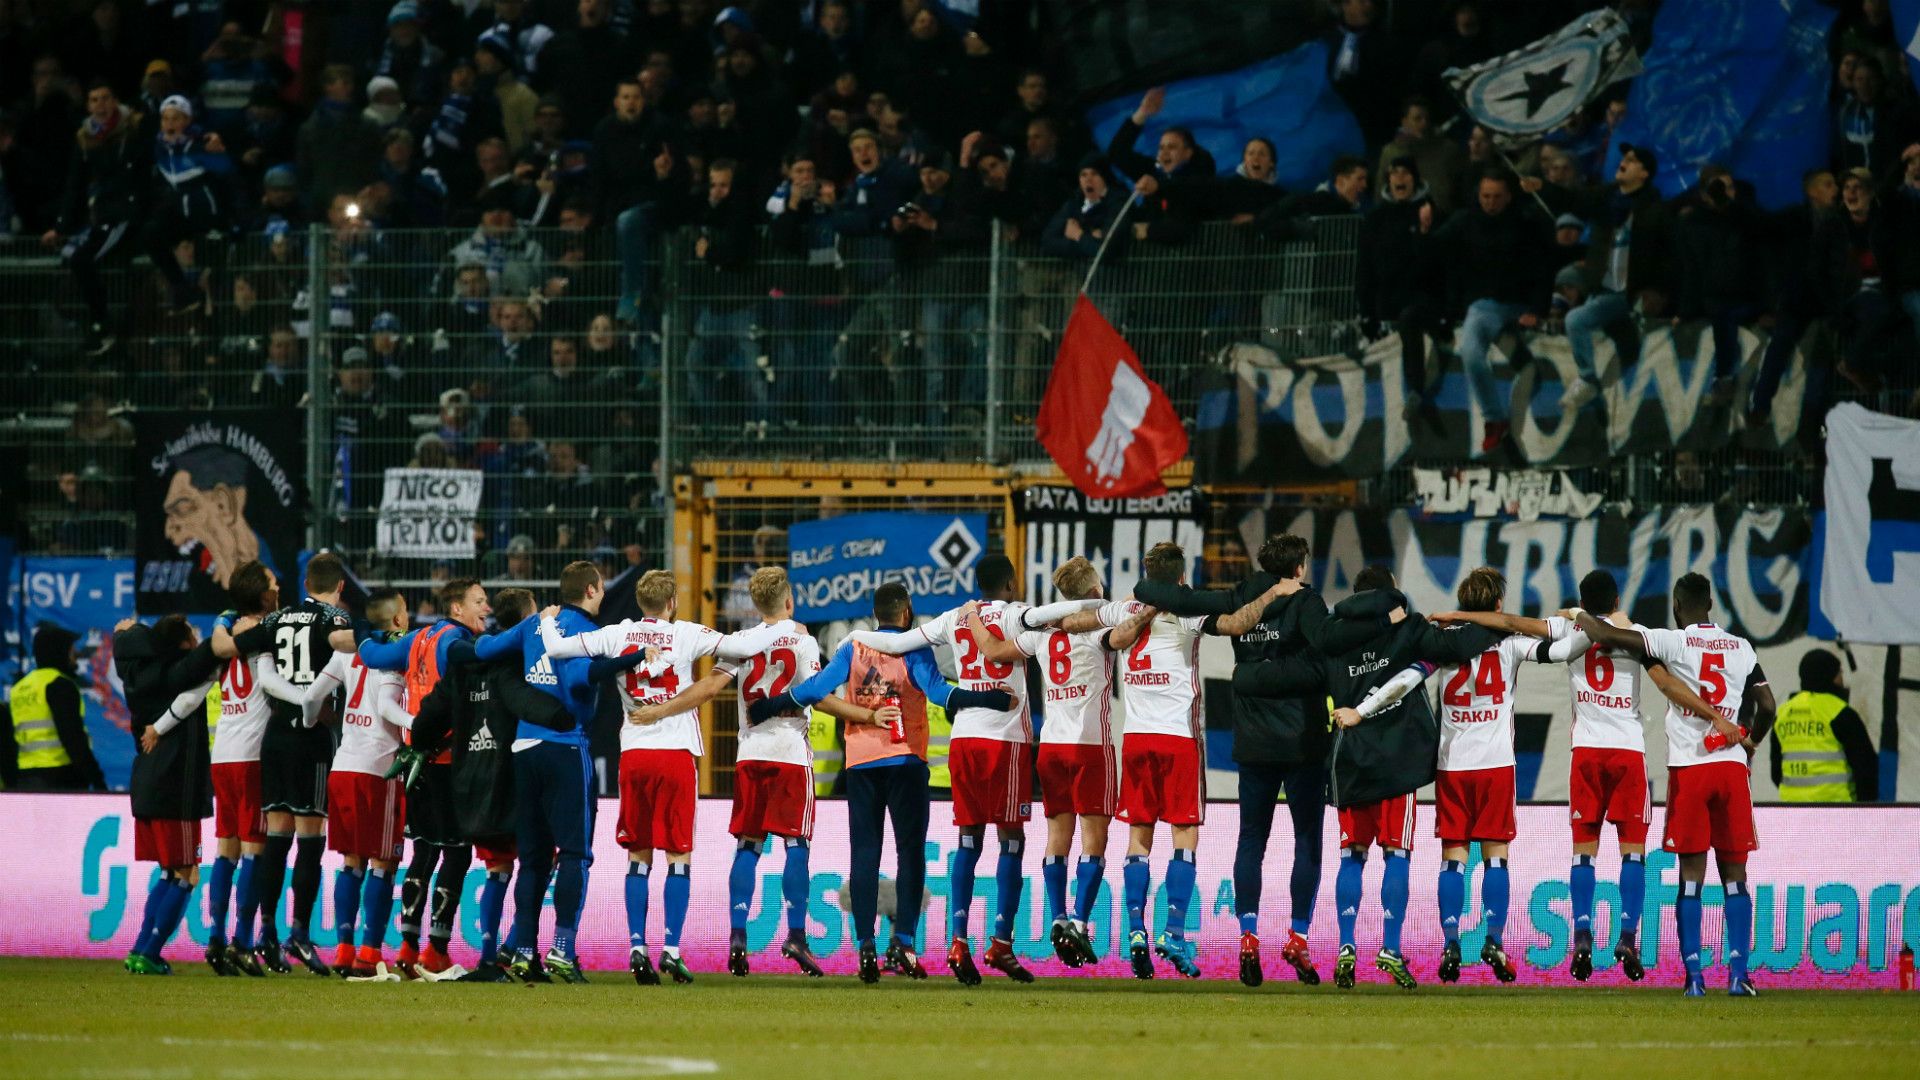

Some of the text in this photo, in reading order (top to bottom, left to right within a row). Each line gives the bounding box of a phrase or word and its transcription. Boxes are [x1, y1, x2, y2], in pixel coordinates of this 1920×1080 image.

[398, 476, 460, 500] NICO
[384, 517, 475, 547] TRIKOT
[791, 539, 887, 568] BLUE CREW
[1127, 625, 1152, 672] 2
[1240, 630, 1280, 643] Emirates
[275, 626, 315, 683] 31
[1049, 631, 1072, 685] 8
[1348, 656, 1390, 678] Emirates
[1585, 642, 1614, 692] 6
[348, 653, 368, 709] 7
[525, 673, 558, 685] adidas
[742, 648, 797, 698] 22
[1443, 650, 1506, 707] 24
[1699, 652, 1727, 705] 5
[345, 713, 372, 727] OOD
[1451, 709, 1499, 723] SAKAI
[1790, 763, 1808, 776] 118
